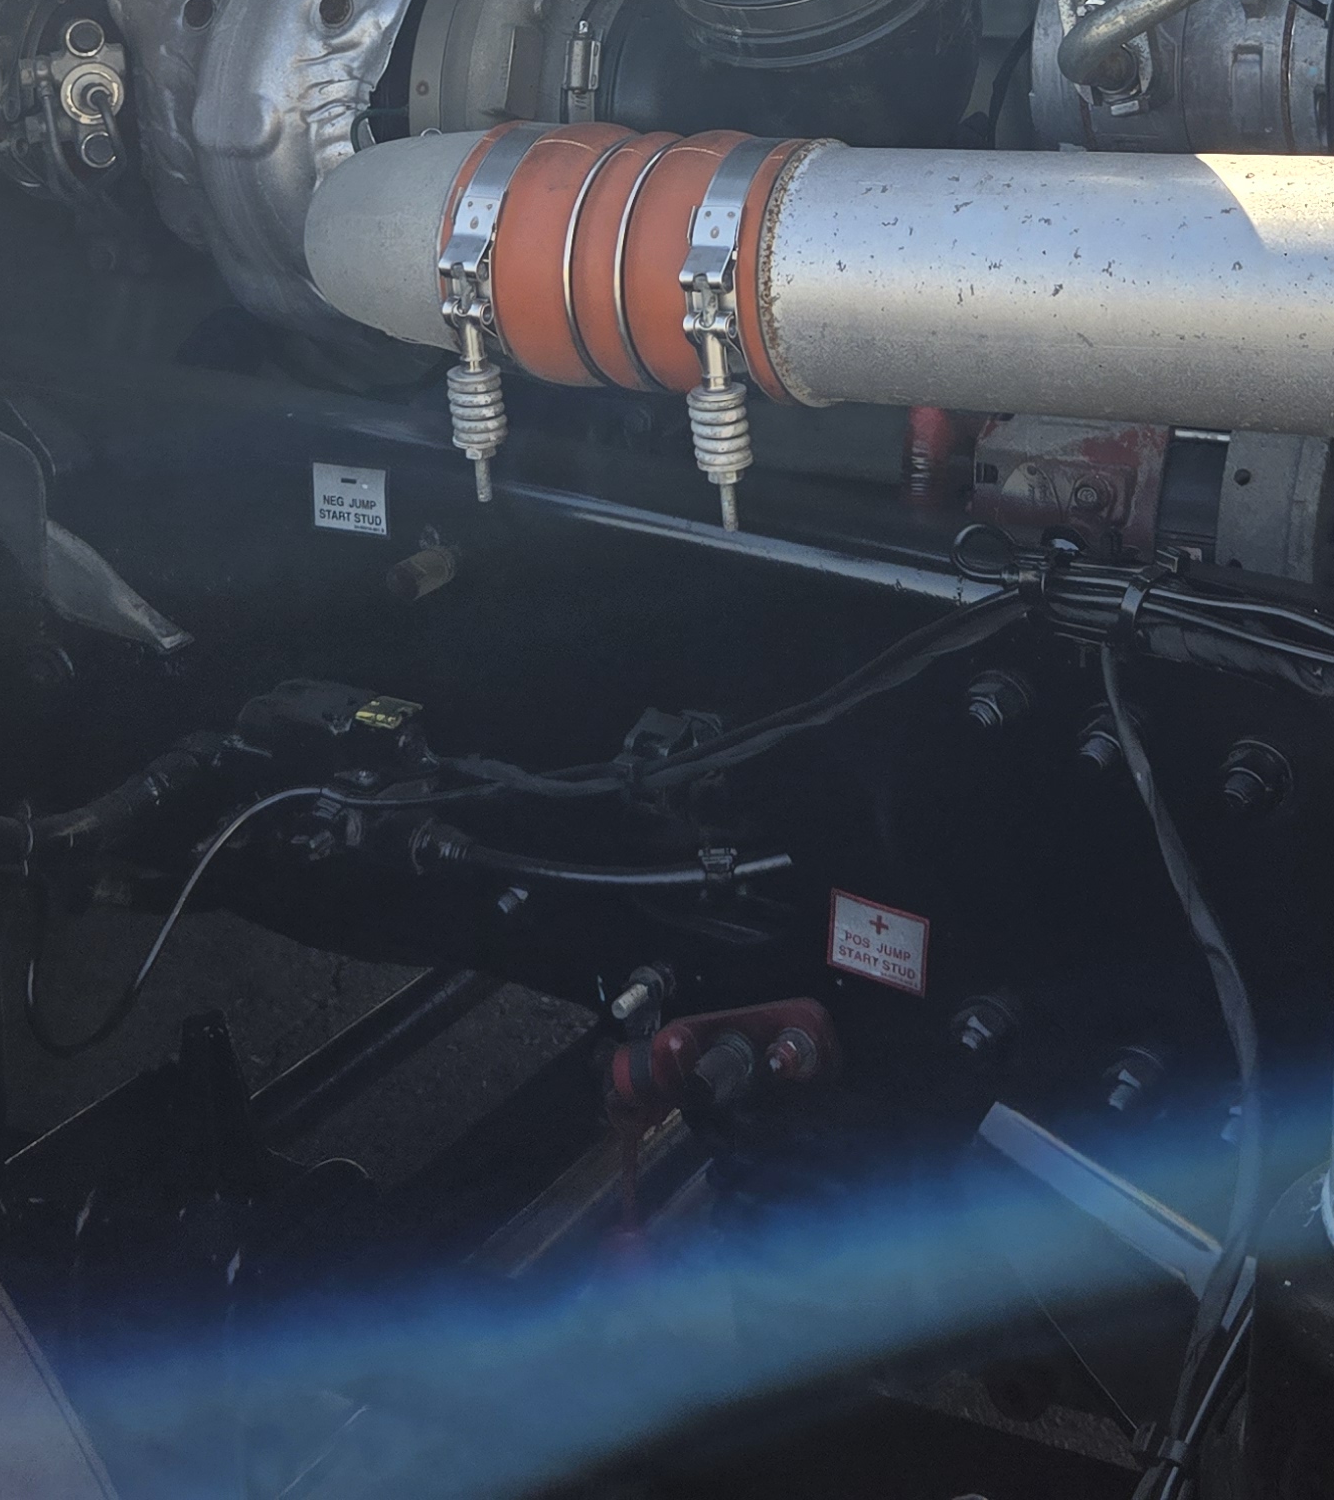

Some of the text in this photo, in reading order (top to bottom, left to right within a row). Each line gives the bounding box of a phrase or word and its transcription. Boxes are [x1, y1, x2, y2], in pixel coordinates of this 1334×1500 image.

[323, 494, 377, 510] NEG JUMP
[319, 508, 382, 526] START STUD
[844, 930, 911, 962] POS JUMP
[839, 946, 879, 967] START
[882, 960, 917, 980] STUD
